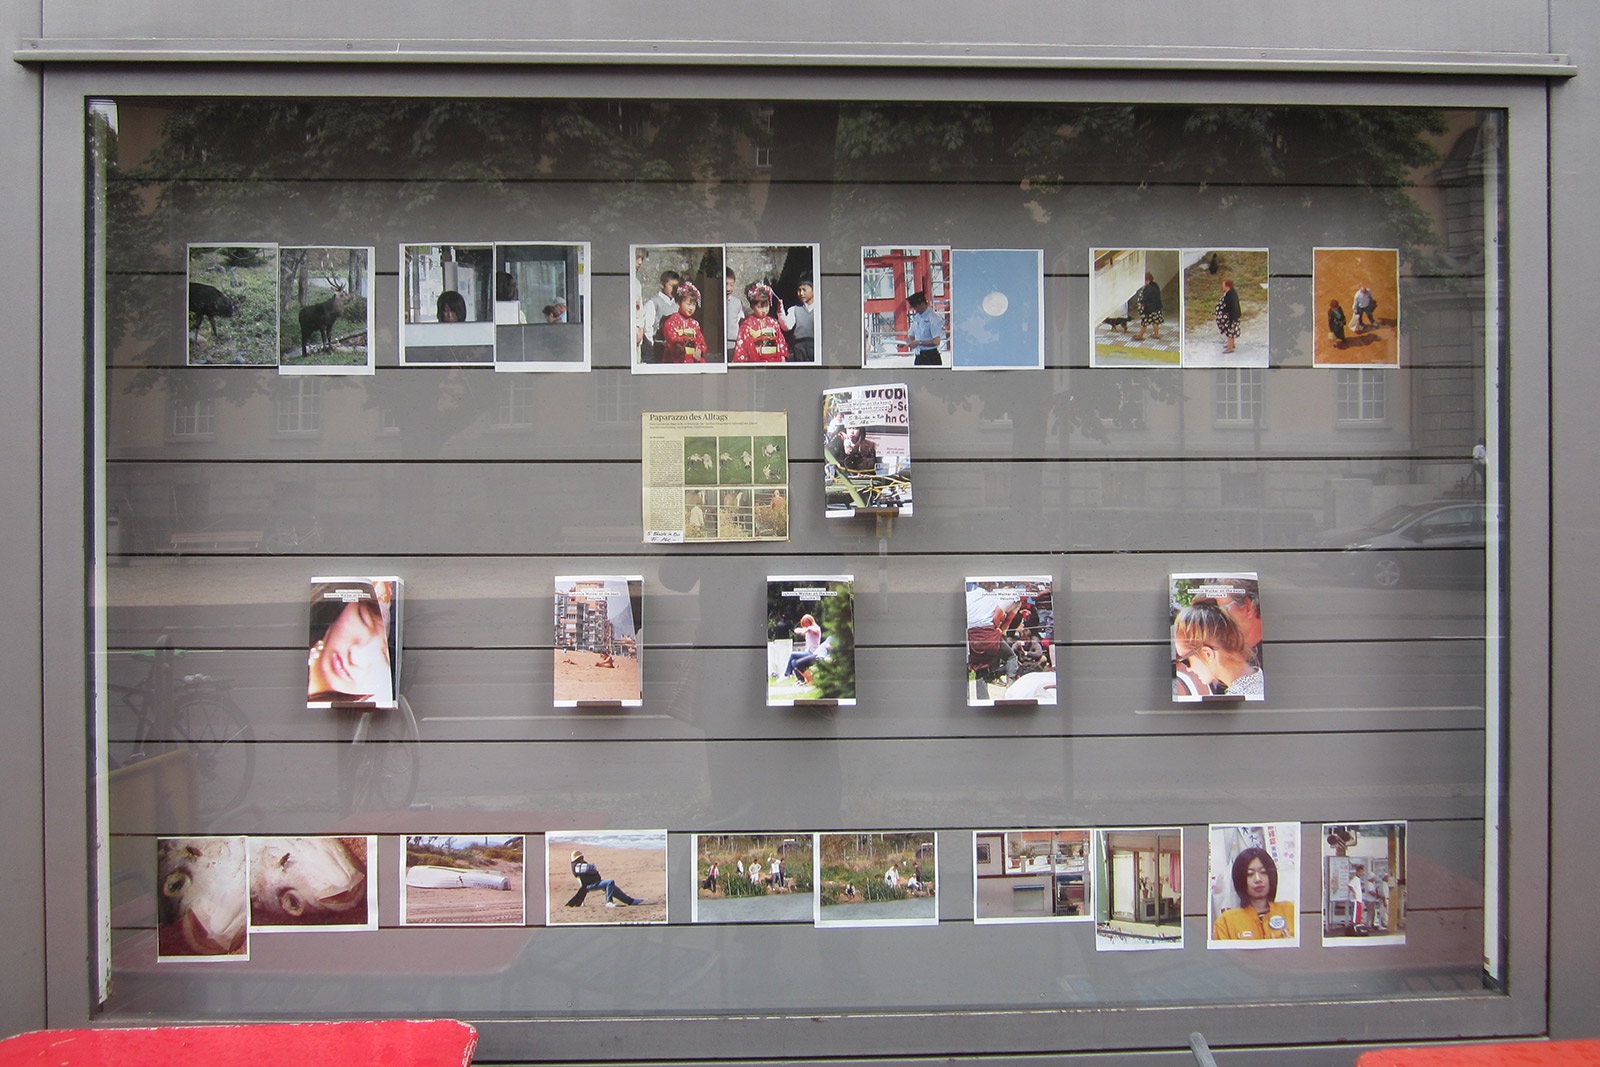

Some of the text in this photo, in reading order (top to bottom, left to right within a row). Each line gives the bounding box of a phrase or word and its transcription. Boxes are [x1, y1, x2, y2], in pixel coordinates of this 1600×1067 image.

[649, 413, 728, 423] Paparazzo des Alltags
